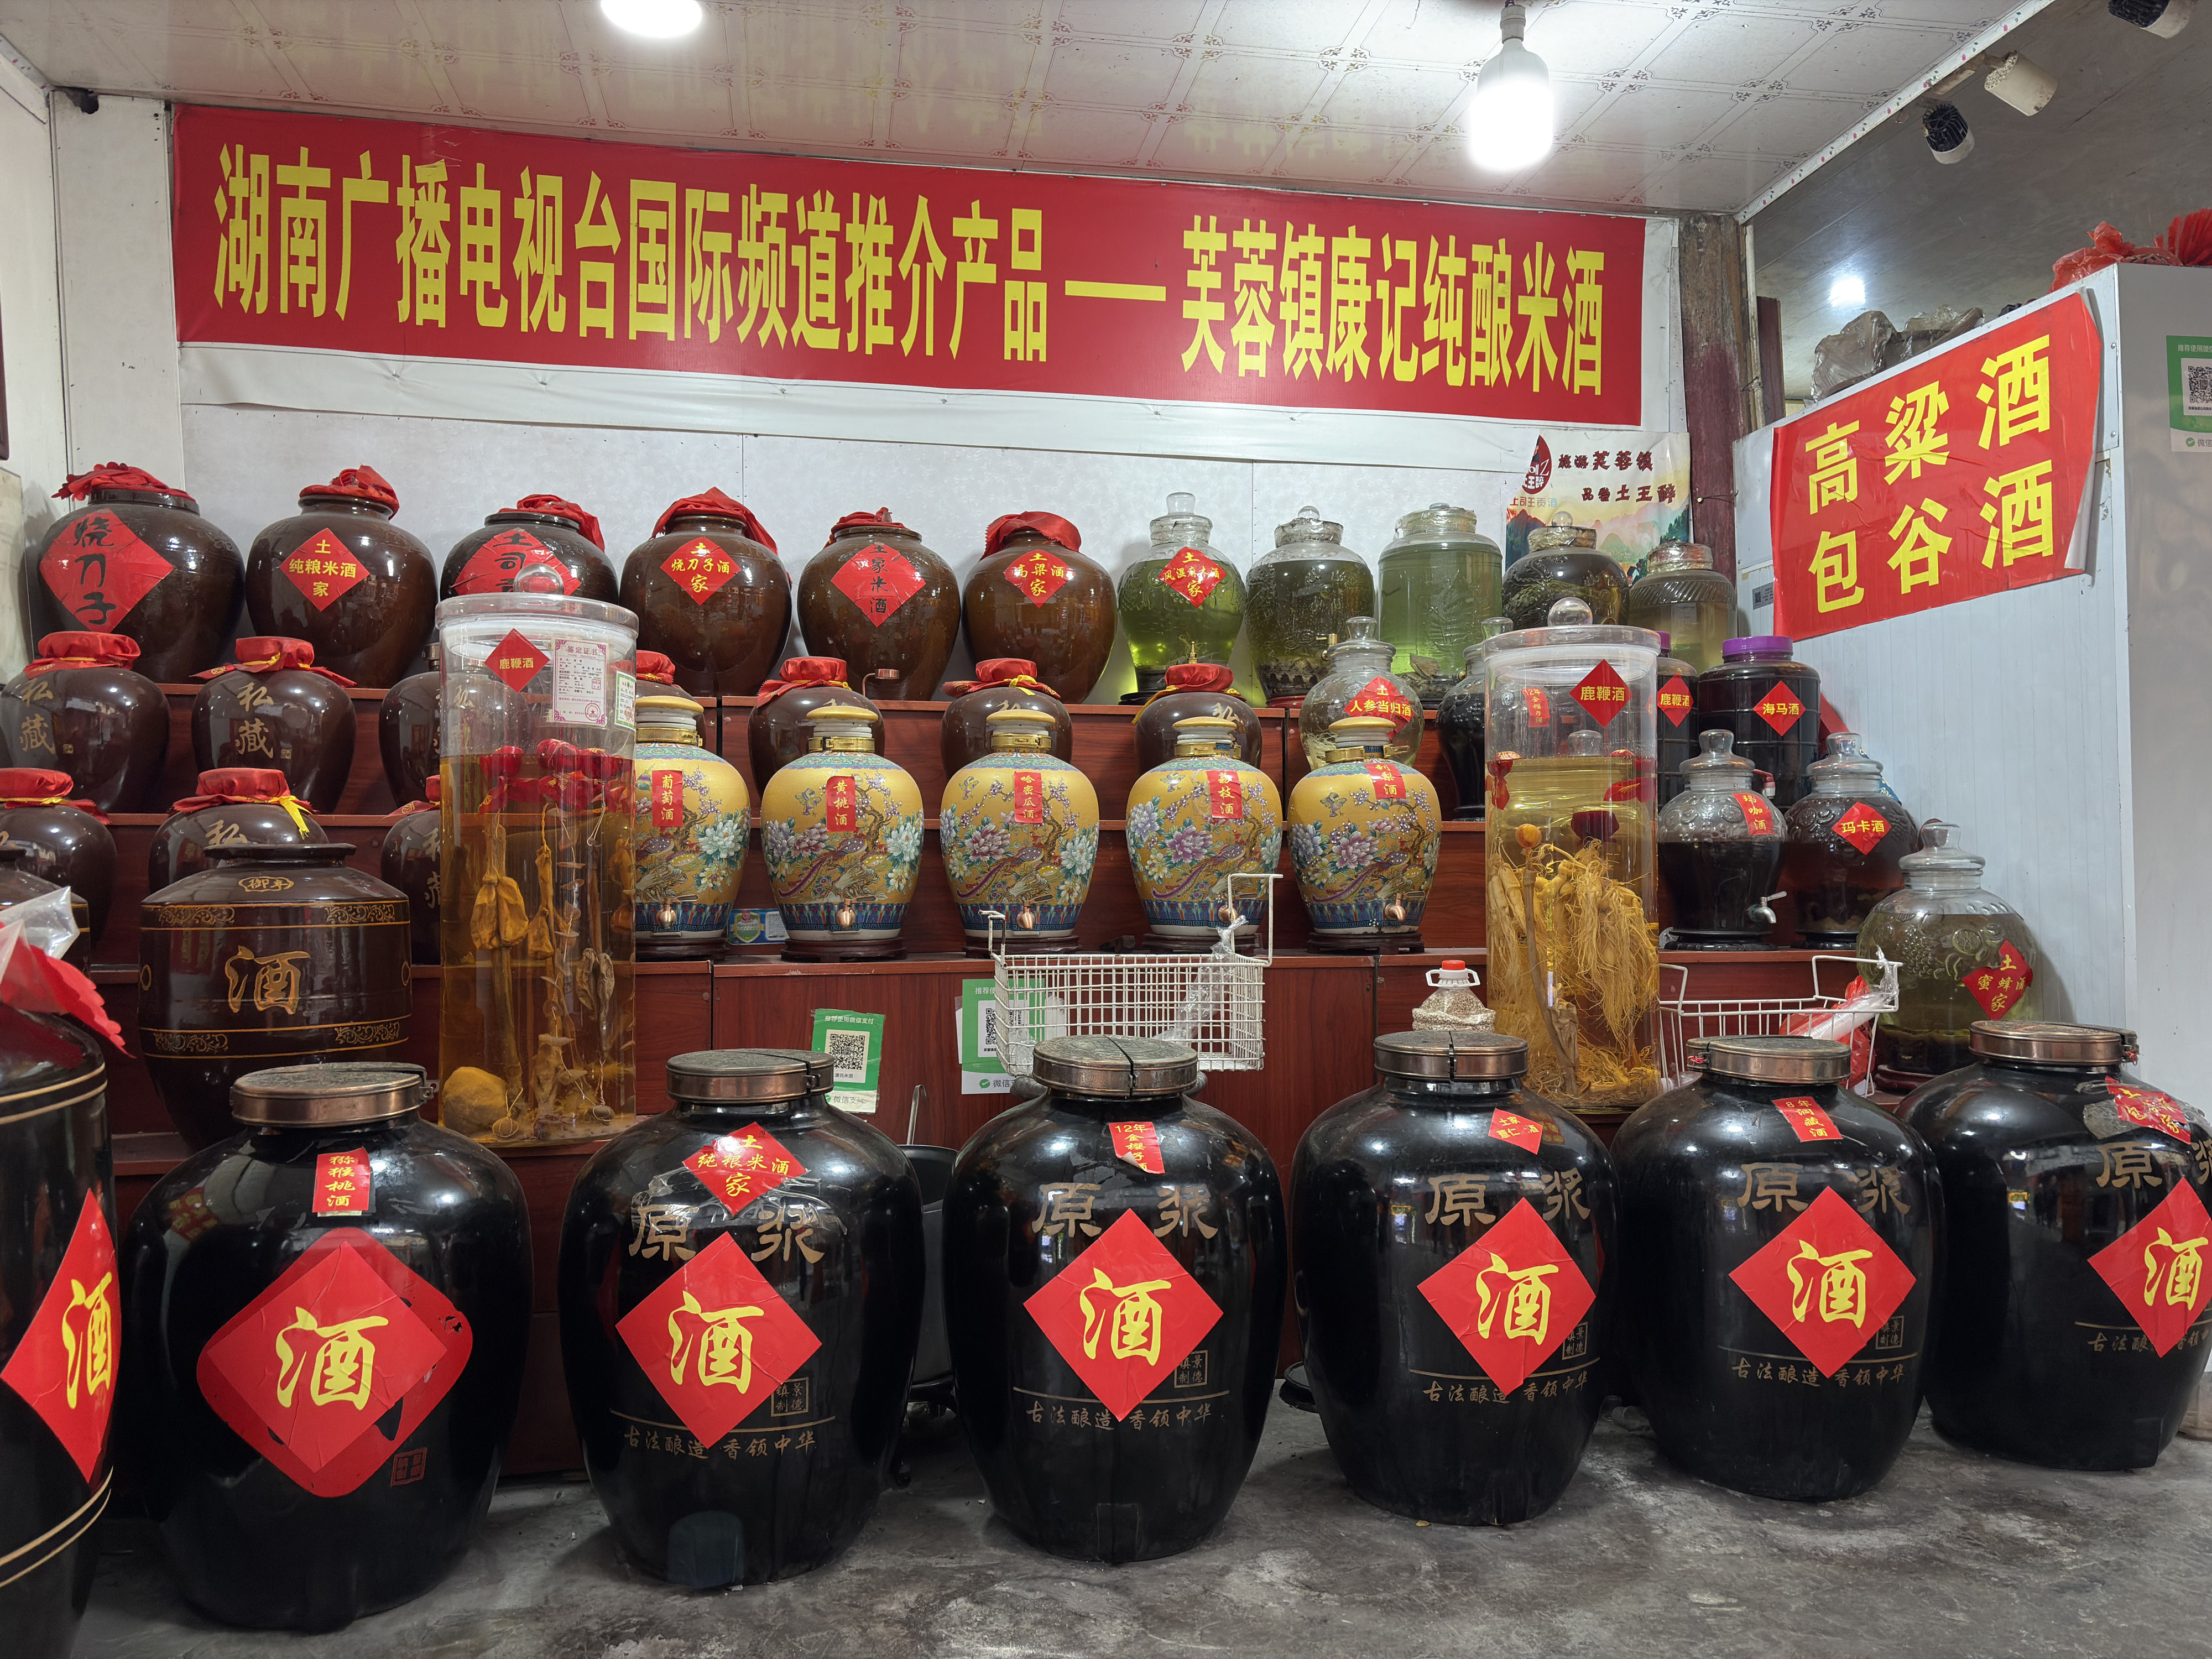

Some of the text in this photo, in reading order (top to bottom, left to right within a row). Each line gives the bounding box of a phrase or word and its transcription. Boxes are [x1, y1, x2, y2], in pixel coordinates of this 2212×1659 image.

[1806, 334, 2050, 515] 高粱酒
[1558, 450, 1653, 472] 旅游芙蓉镇
[1581, 483, 1677, 504] 品尝土王醉
[315, 540, 331, 554] 土
[1809, 460, 2053, 614] 包谷酒
[671, 558, 729, 574] 烧刀子酒
[1029, 553, 1047, 561] 土
[1182, 552, 1199, 563] 土
[73, 518, 117, 625] 烧刀子
[289, 559, 357, 578] 纯粮米酒
[869, 545, 889, 614] 土家米酒
[313, 581, 329, 597] 家
[691, 574, 708, 593] 家
[1030, 578, 1046, 596] 家
[1187, 580, 1203, 597] 家
[567, 645, 598, 655] 鉴定证书
[499, 657, 534, 670] 鹿鞭酒
[1580, 686, 1625, 702] 鹿鞭酒
[1660, 693, 1691, 707] 鹿鞭酒
[19, 679, 56, 754] 私藏
[1350, 700, 1411, 717] 人参当归酒
[1762, 702, 1799, 716] 海马酒
[235, 682, 275, 759] 私藏
[1375, 764, 1397, 795] 刺梨酒
[661, 774, 673, 821] 葡萄酒
[834, 780, 850, 827] 黄桃酒
[1020, 775, 1035, 819] 哈密瓜酒
[1217, 772, 1235, 815] 荔枝酒
[1743, 793, 1766, 831] 玛咖酒
[1841, 819, 1885, 834] 玛卡酒
[2000, 954, 2017, 971] 土
[224, 945, 311, 1015] 酒
[1978, 974, 2026, 992] 蜜蜂酒
[1991, 993, 2008, 1011] 家
[825, 1015, 874, 1024] 推荐使用微信支付
[1115, 1124, 1147, 1133] 12年
[1499, 1117, 1521, 1126] 土家
[1796, 1108, 1828, 1137] 洞藏酒
[738, 1135, 763, 1149] 土
[698, 1153, 790, 1175] 纯粮米酒
[325, 1156, 356, 1207] 猕猴桃酒
[726, 1172, 751, 1197] 家
[1737, 1162, 1911, 1214] 原浆
[1425, 1167, 1591, 1227] 原浆
[1031, 1182, 1218, 1239] 原浆
[2144, 1227, 2209, 1311] 酒
[1787, 1240, 1872, 1328] 酒
[1476, 1253, 1559, 1345] 酒
[1079, 1267, 1171, 1366] 酒
[62, 1271, 112, 1410] 酒
[668, 1290, 765, 1394] 酒
[2088, 1332, 2154, 1353] 古法酿
[275, 1306, 389, 1410] 酒
